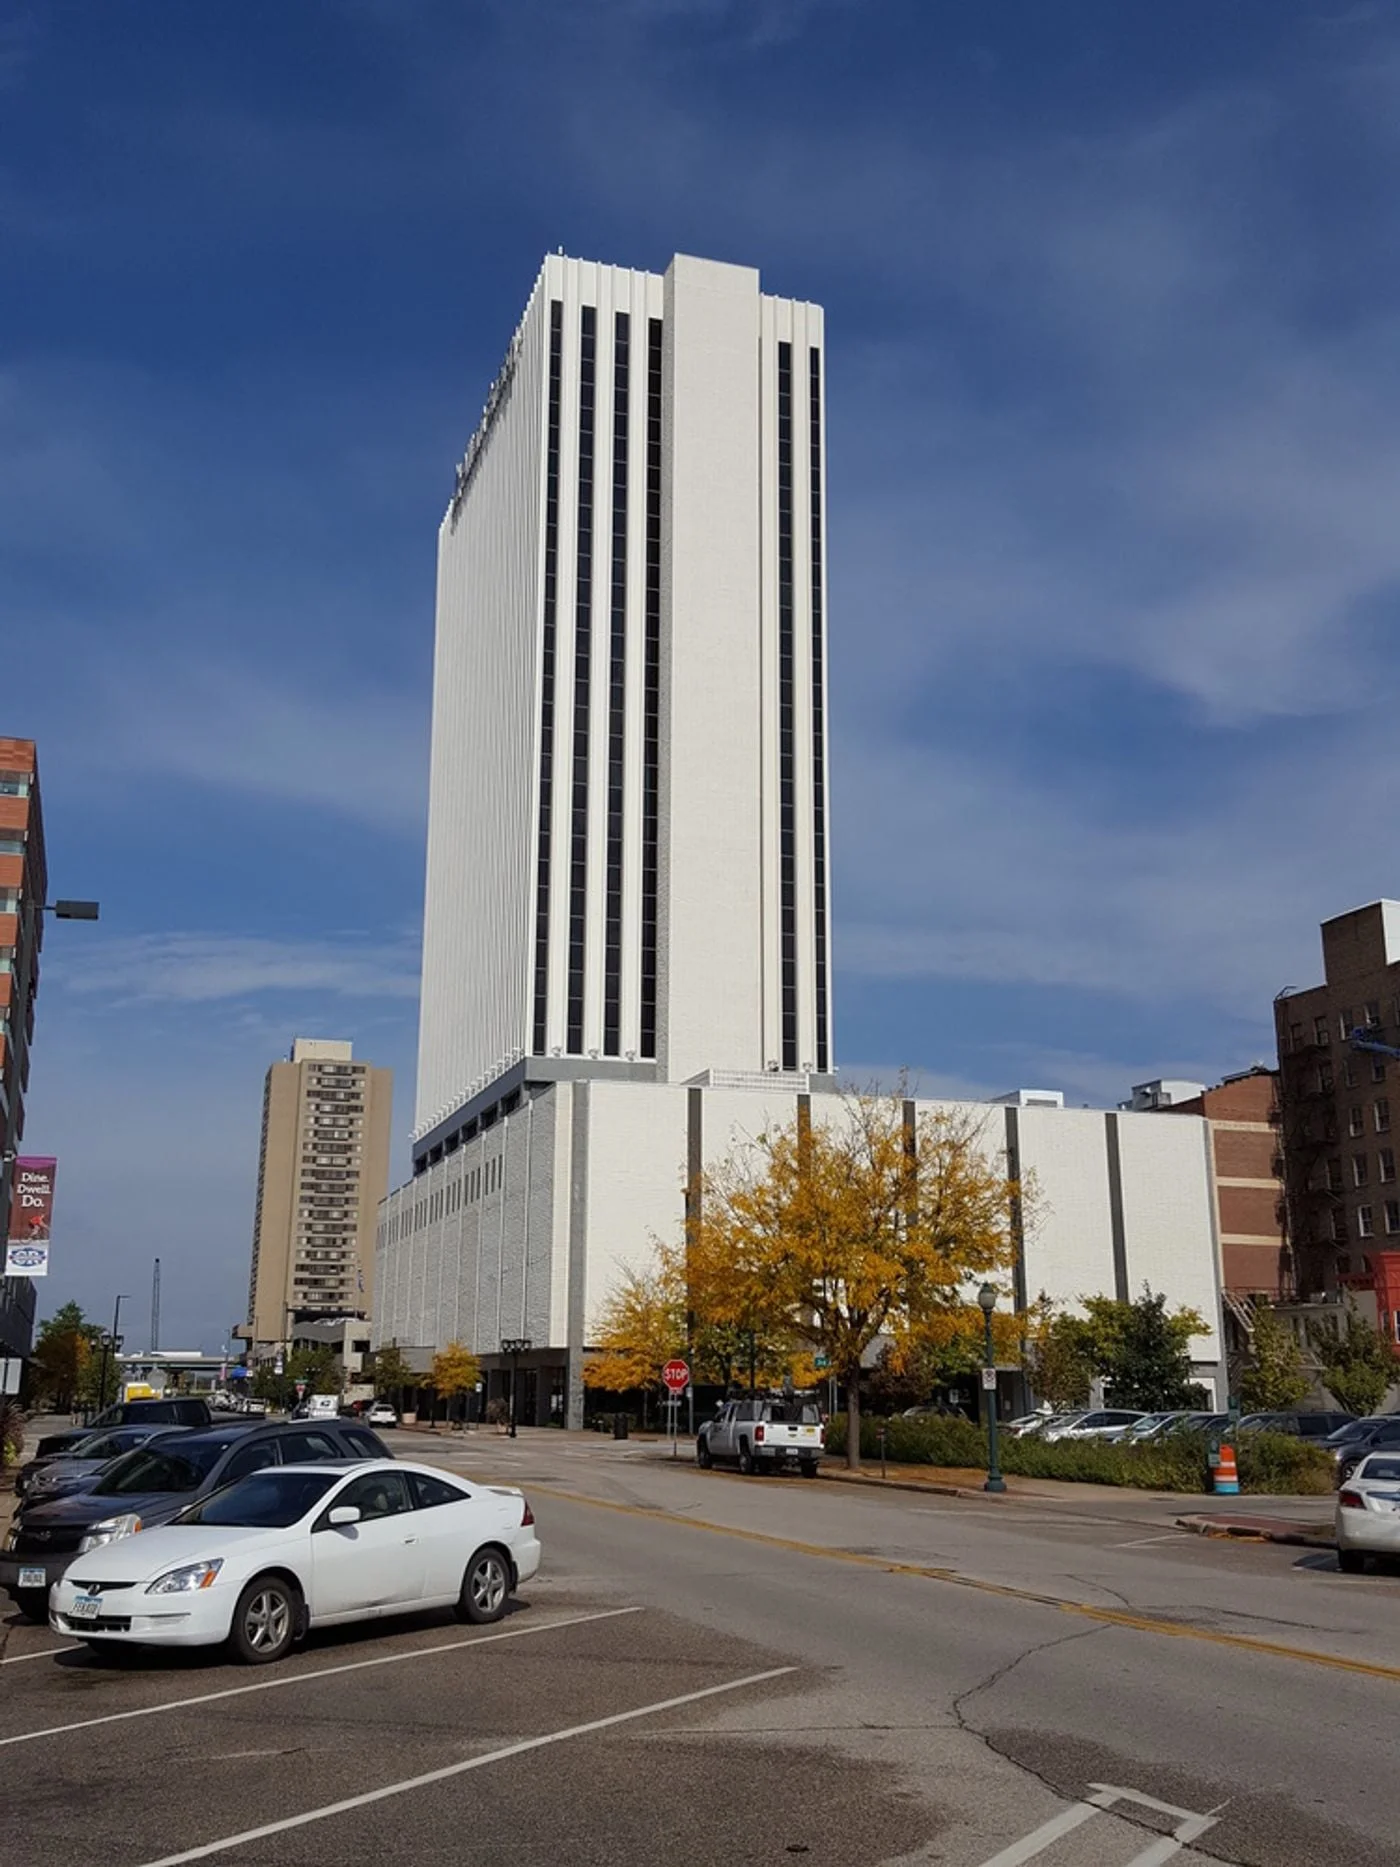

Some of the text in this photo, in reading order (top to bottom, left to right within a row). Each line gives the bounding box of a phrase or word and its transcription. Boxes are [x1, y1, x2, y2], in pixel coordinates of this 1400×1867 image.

[17, 1184, 51, 1194] Dwell.
[21, 1195, 44, 1207] Do.
[664, 1368, 688, 1380] STOP
